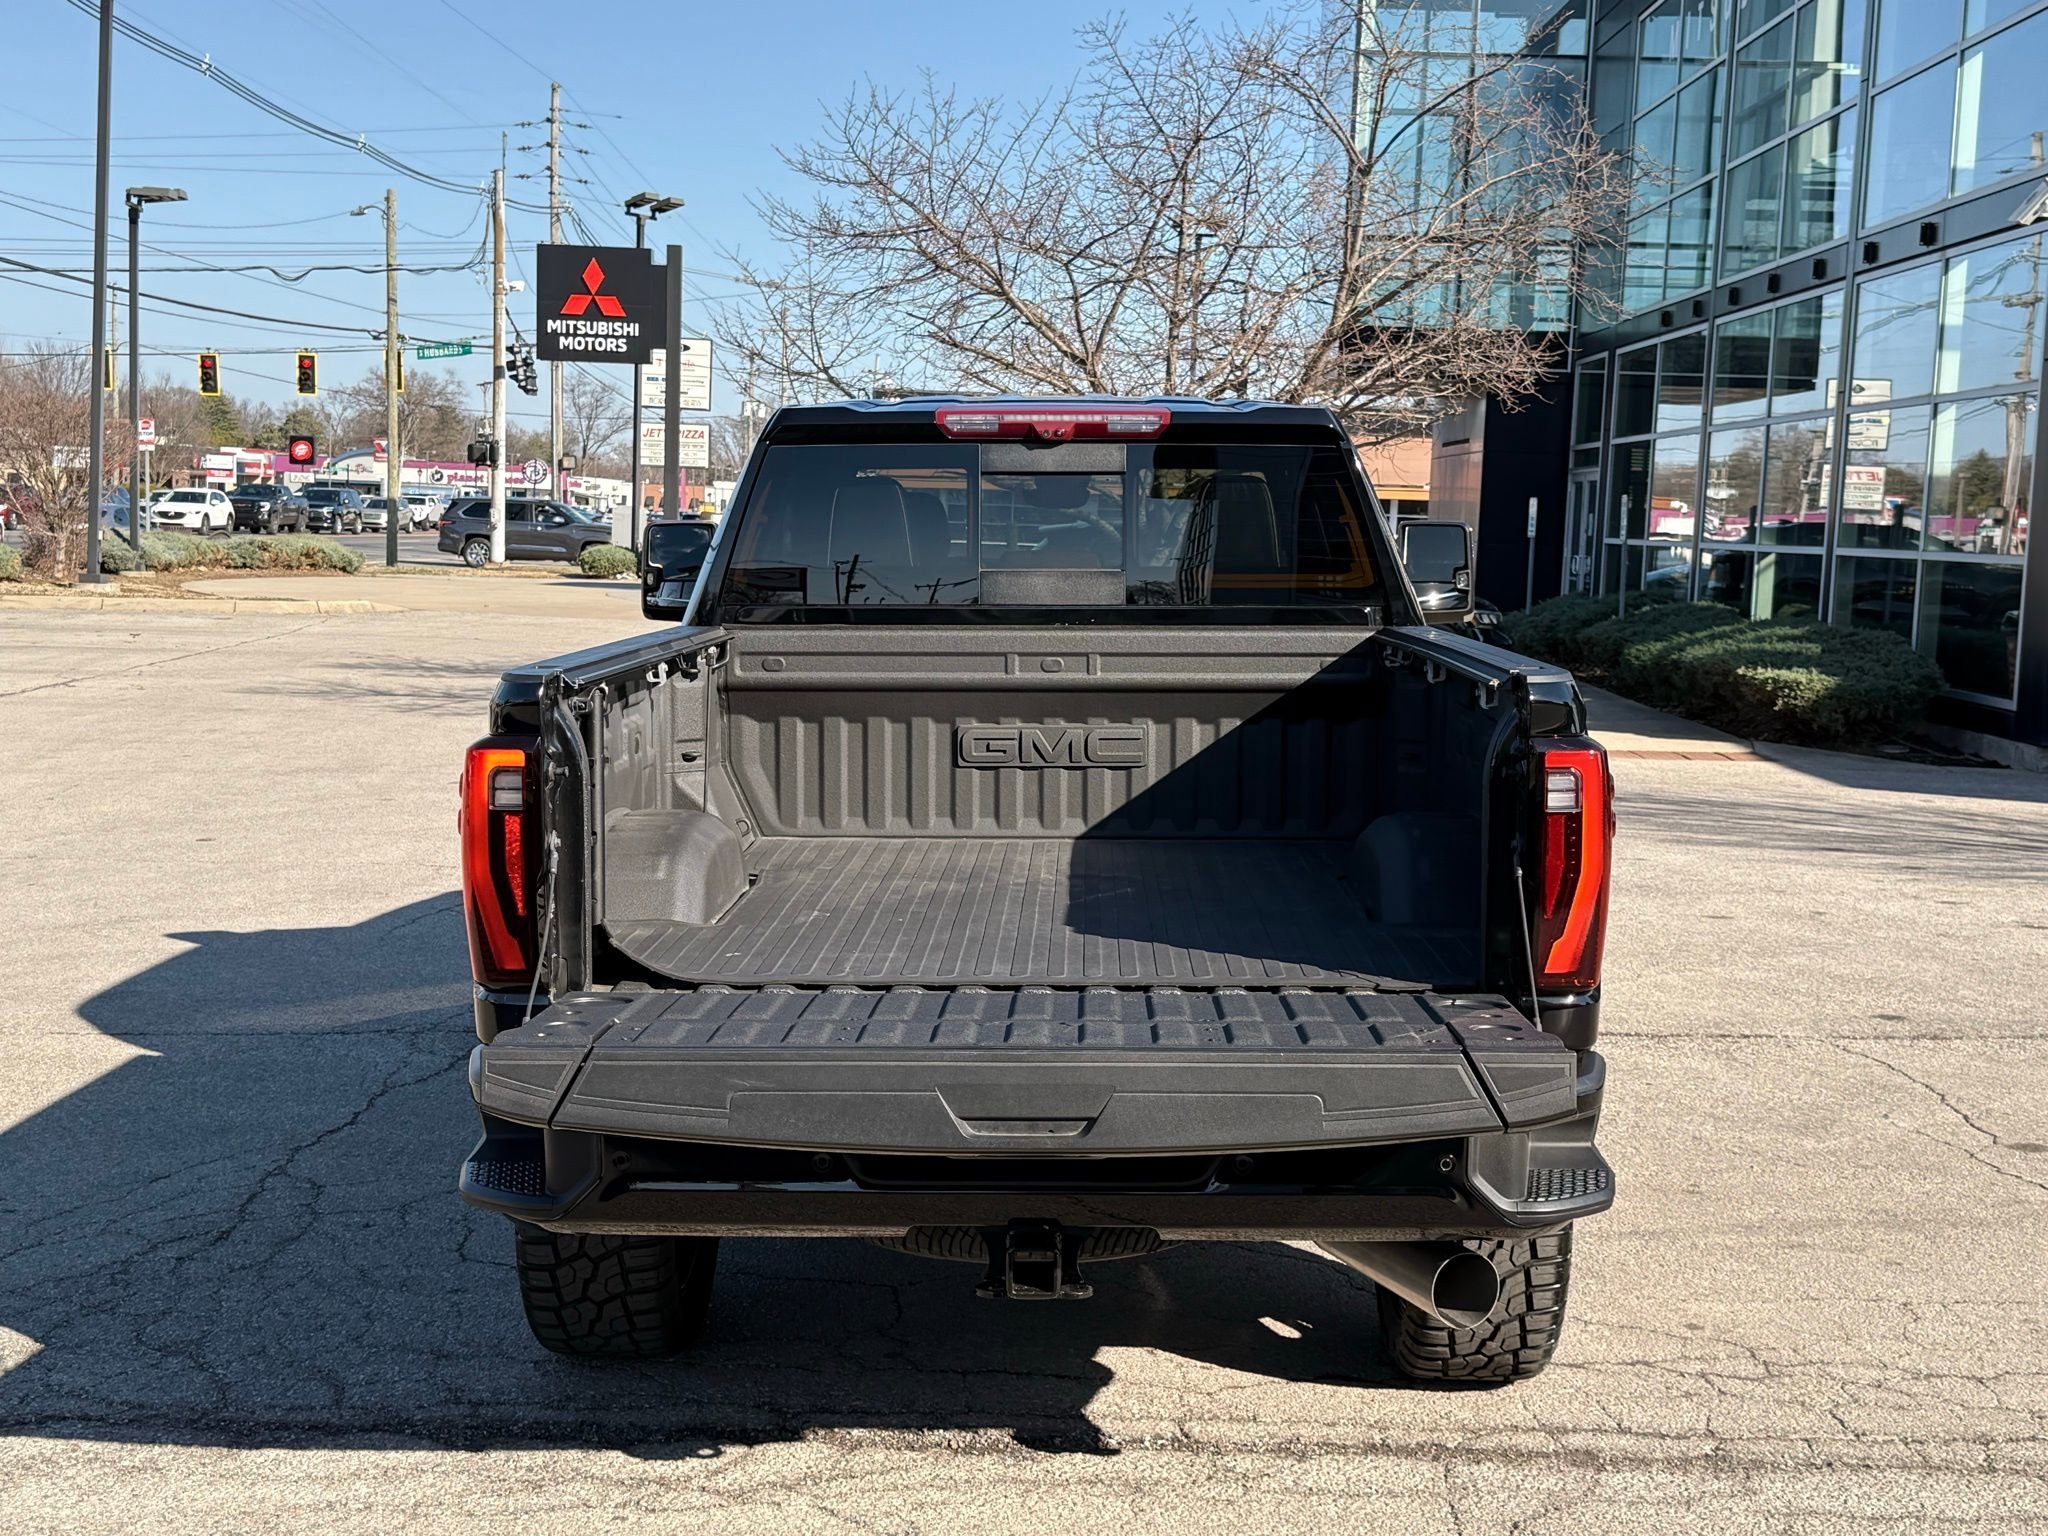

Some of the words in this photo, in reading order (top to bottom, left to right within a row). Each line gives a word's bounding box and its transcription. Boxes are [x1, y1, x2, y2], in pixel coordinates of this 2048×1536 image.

[546, 319, 640, 337] MITSUBISHI
[559, 336, 627, 352] MOTORS
[424, 345, 463, 358] HUBBARDS
[680, 429, 705, 439] IZZA
[447, 472, 484, 485] planet
[959, 728, 1144, 763] GMC
